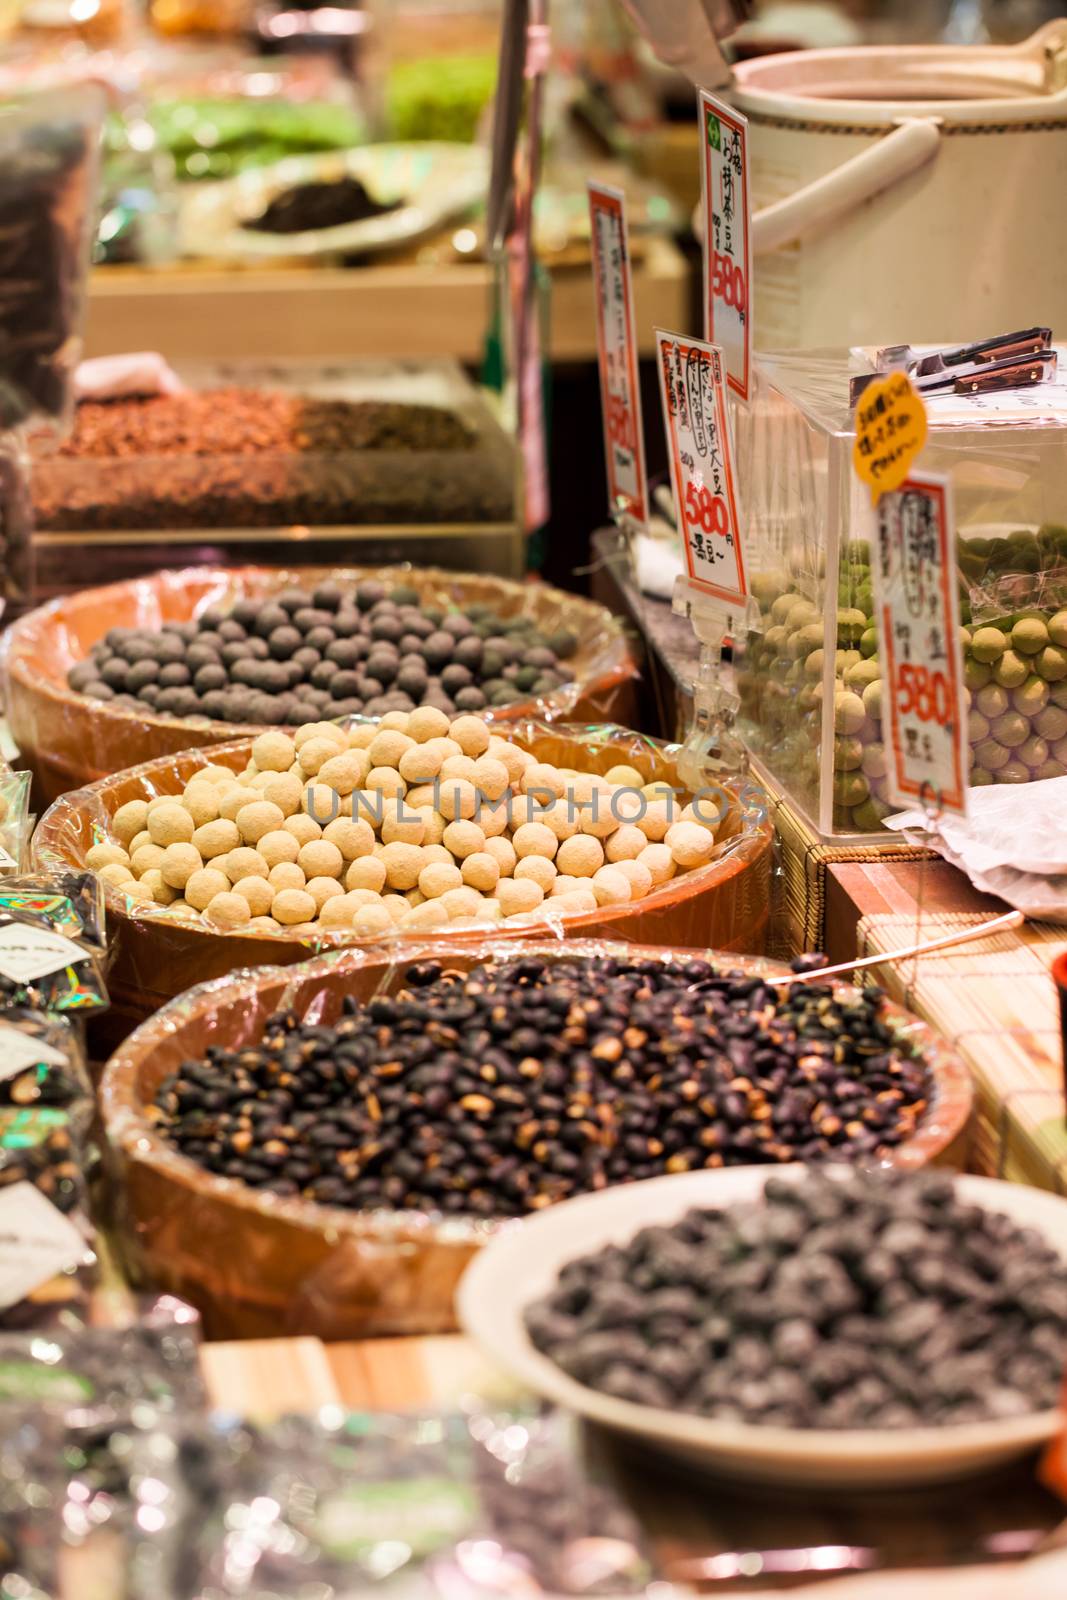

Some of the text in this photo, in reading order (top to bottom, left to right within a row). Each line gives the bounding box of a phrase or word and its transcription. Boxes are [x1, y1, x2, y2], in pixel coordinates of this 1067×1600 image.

[700, 359, 724, 496] きなこ黒大豆
